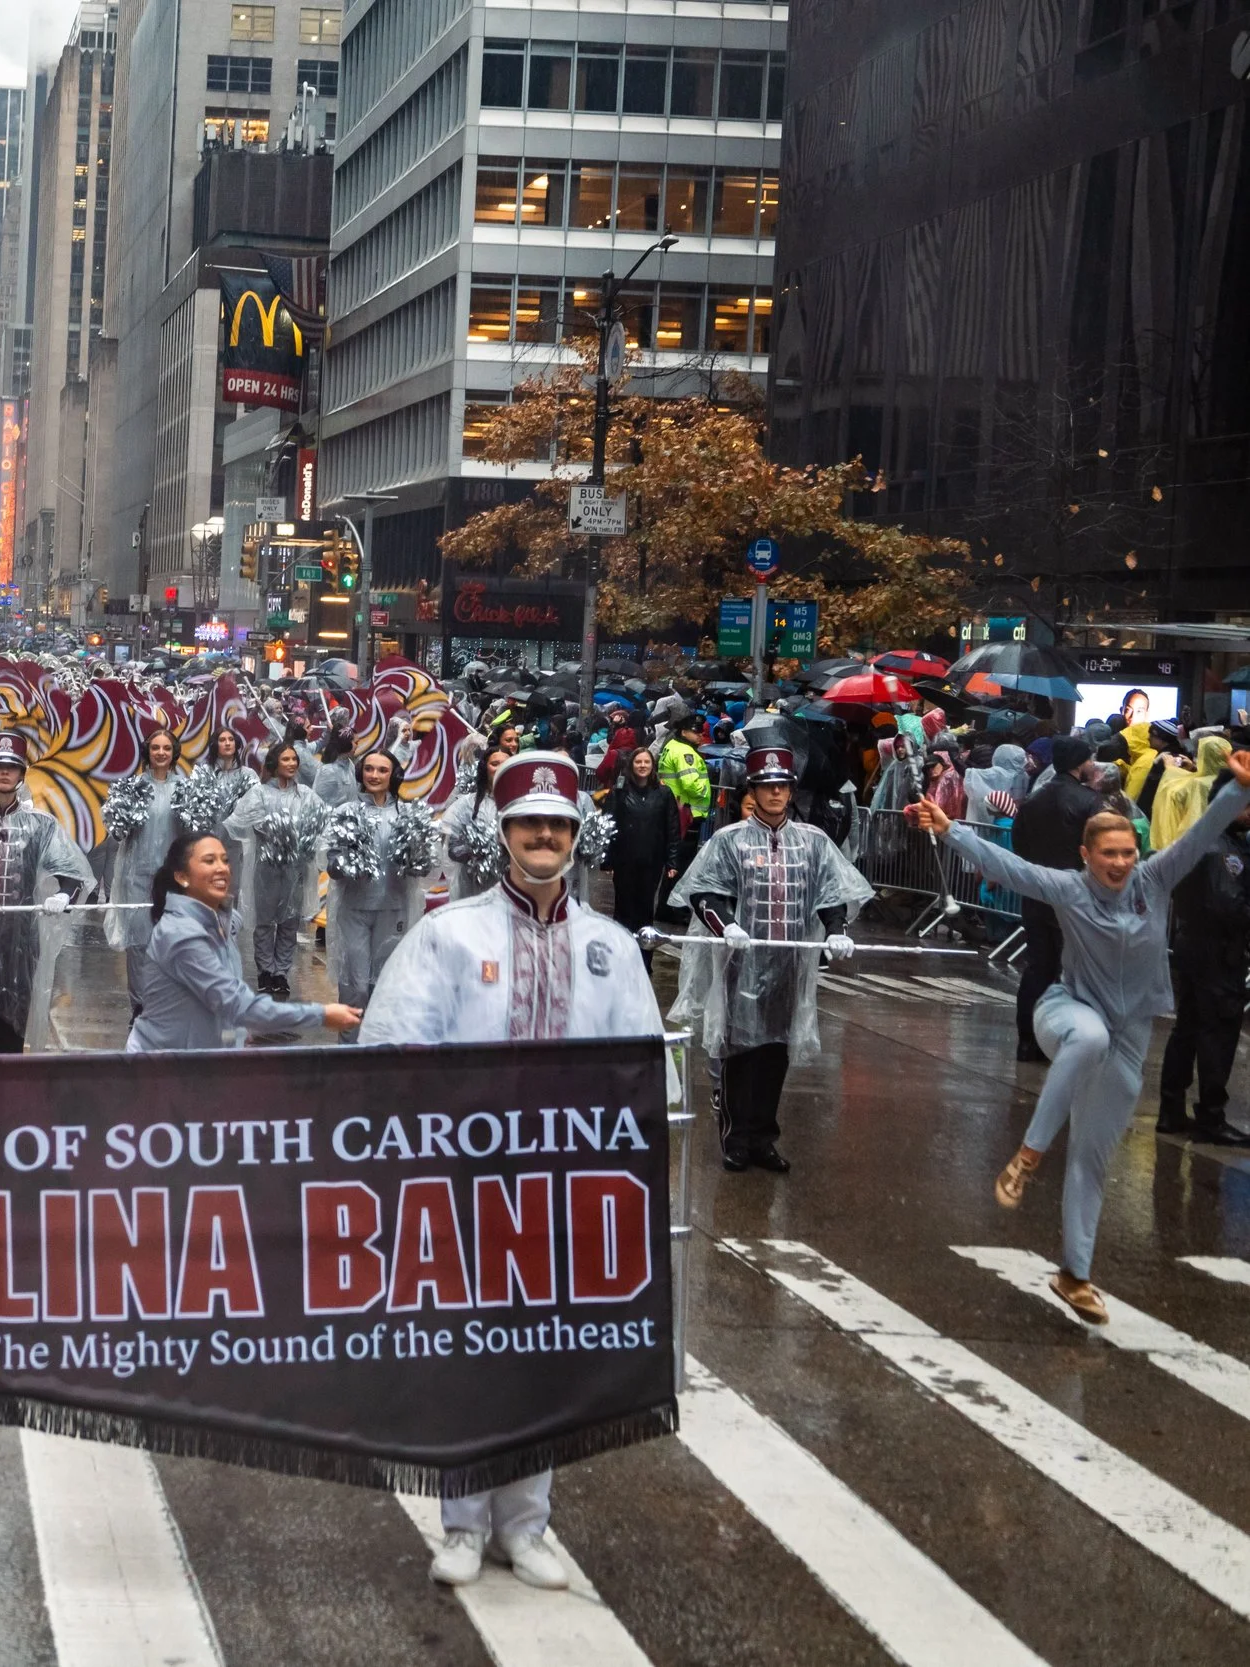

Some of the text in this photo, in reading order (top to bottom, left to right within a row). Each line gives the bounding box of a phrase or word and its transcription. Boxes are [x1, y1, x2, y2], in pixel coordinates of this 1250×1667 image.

[227, 377, 300, 401] OPEN 24 HRS
[1, 403, 14, 470] RADIO
[580, 488, 611, 499] BUS
[583, 506, 612, 517] ONLY
[794, 606, 808, 616] M5
[774, 618, 787, 628] 14
[793, 619, 807, 628] M7
[792, 631, 812, 641] QM3
[792, 644, 811, 653] QM4
[3, 1124, 87, 1171] OF
[105, 1118, 314, 1170] SOUTH
[331, 1106, 649, 1162] CAROLINA
[301, 1169, 652, 1316] BAND
[60, 1331, 199, 1378] Mighty
[210, 1324, 336, 1365] Sound
[345, 1323, 387, 1360] of
[393, 1320, 453, 1359] the
[464, 1315, 656, 1357] Southeast
